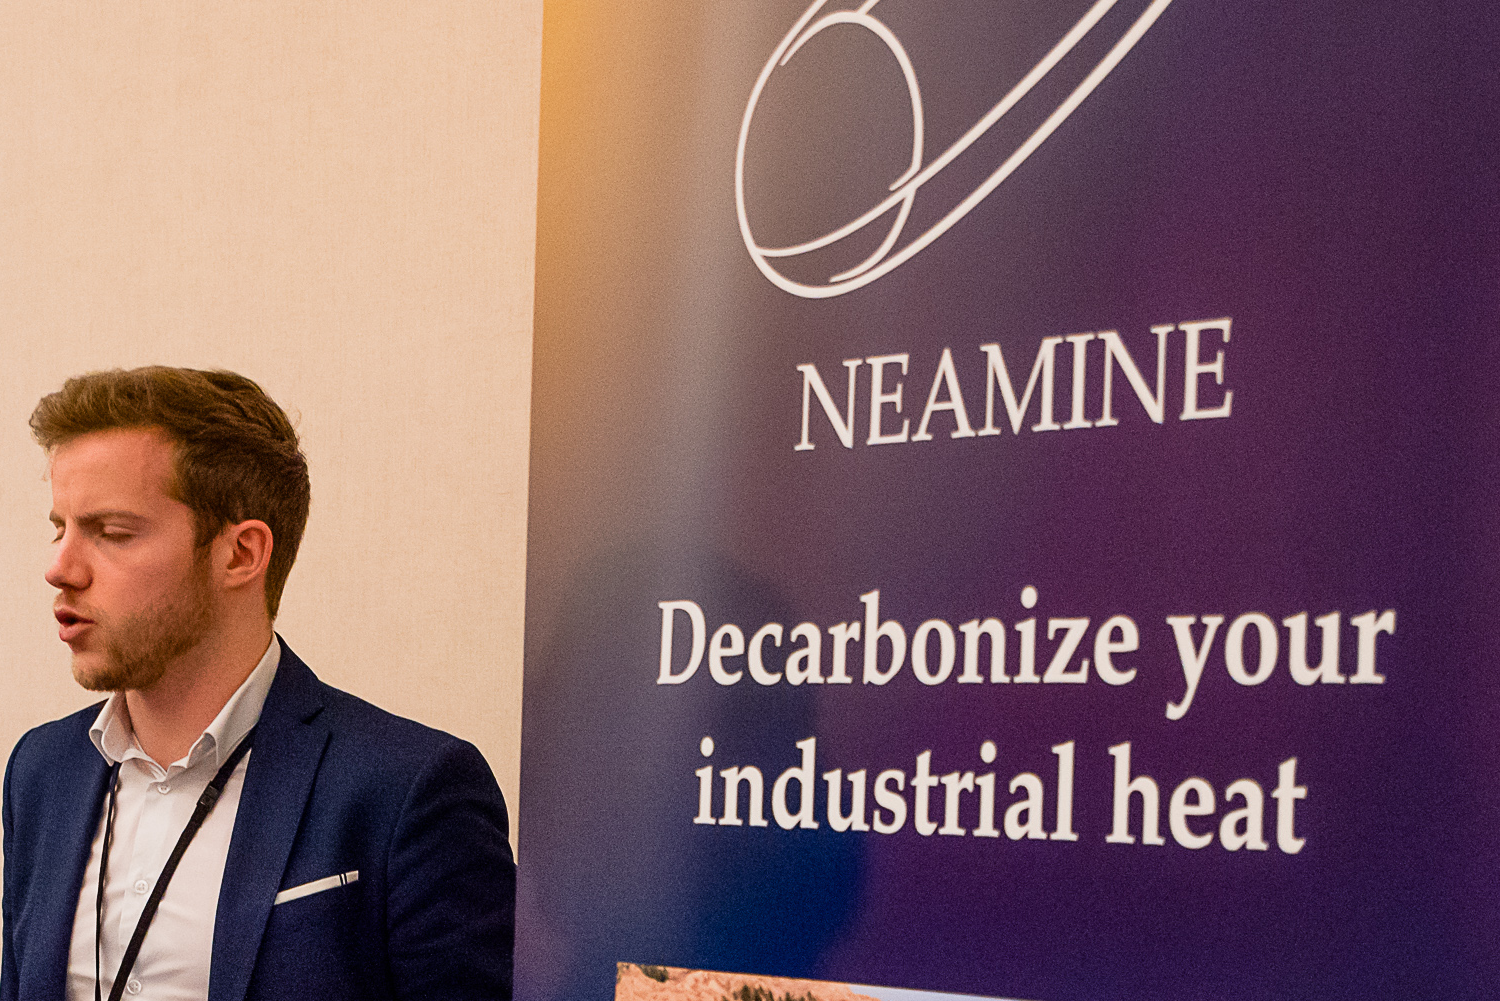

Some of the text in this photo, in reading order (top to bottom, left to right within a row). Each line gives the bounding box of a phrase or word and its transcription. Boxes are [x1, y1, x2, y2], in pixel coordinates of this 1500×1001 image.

[794, 318, 1233, 451] NEAMINE
[656, 587, 1396, 720] Decarbonize your
[694, 736, 1307, 854] industrial heat
